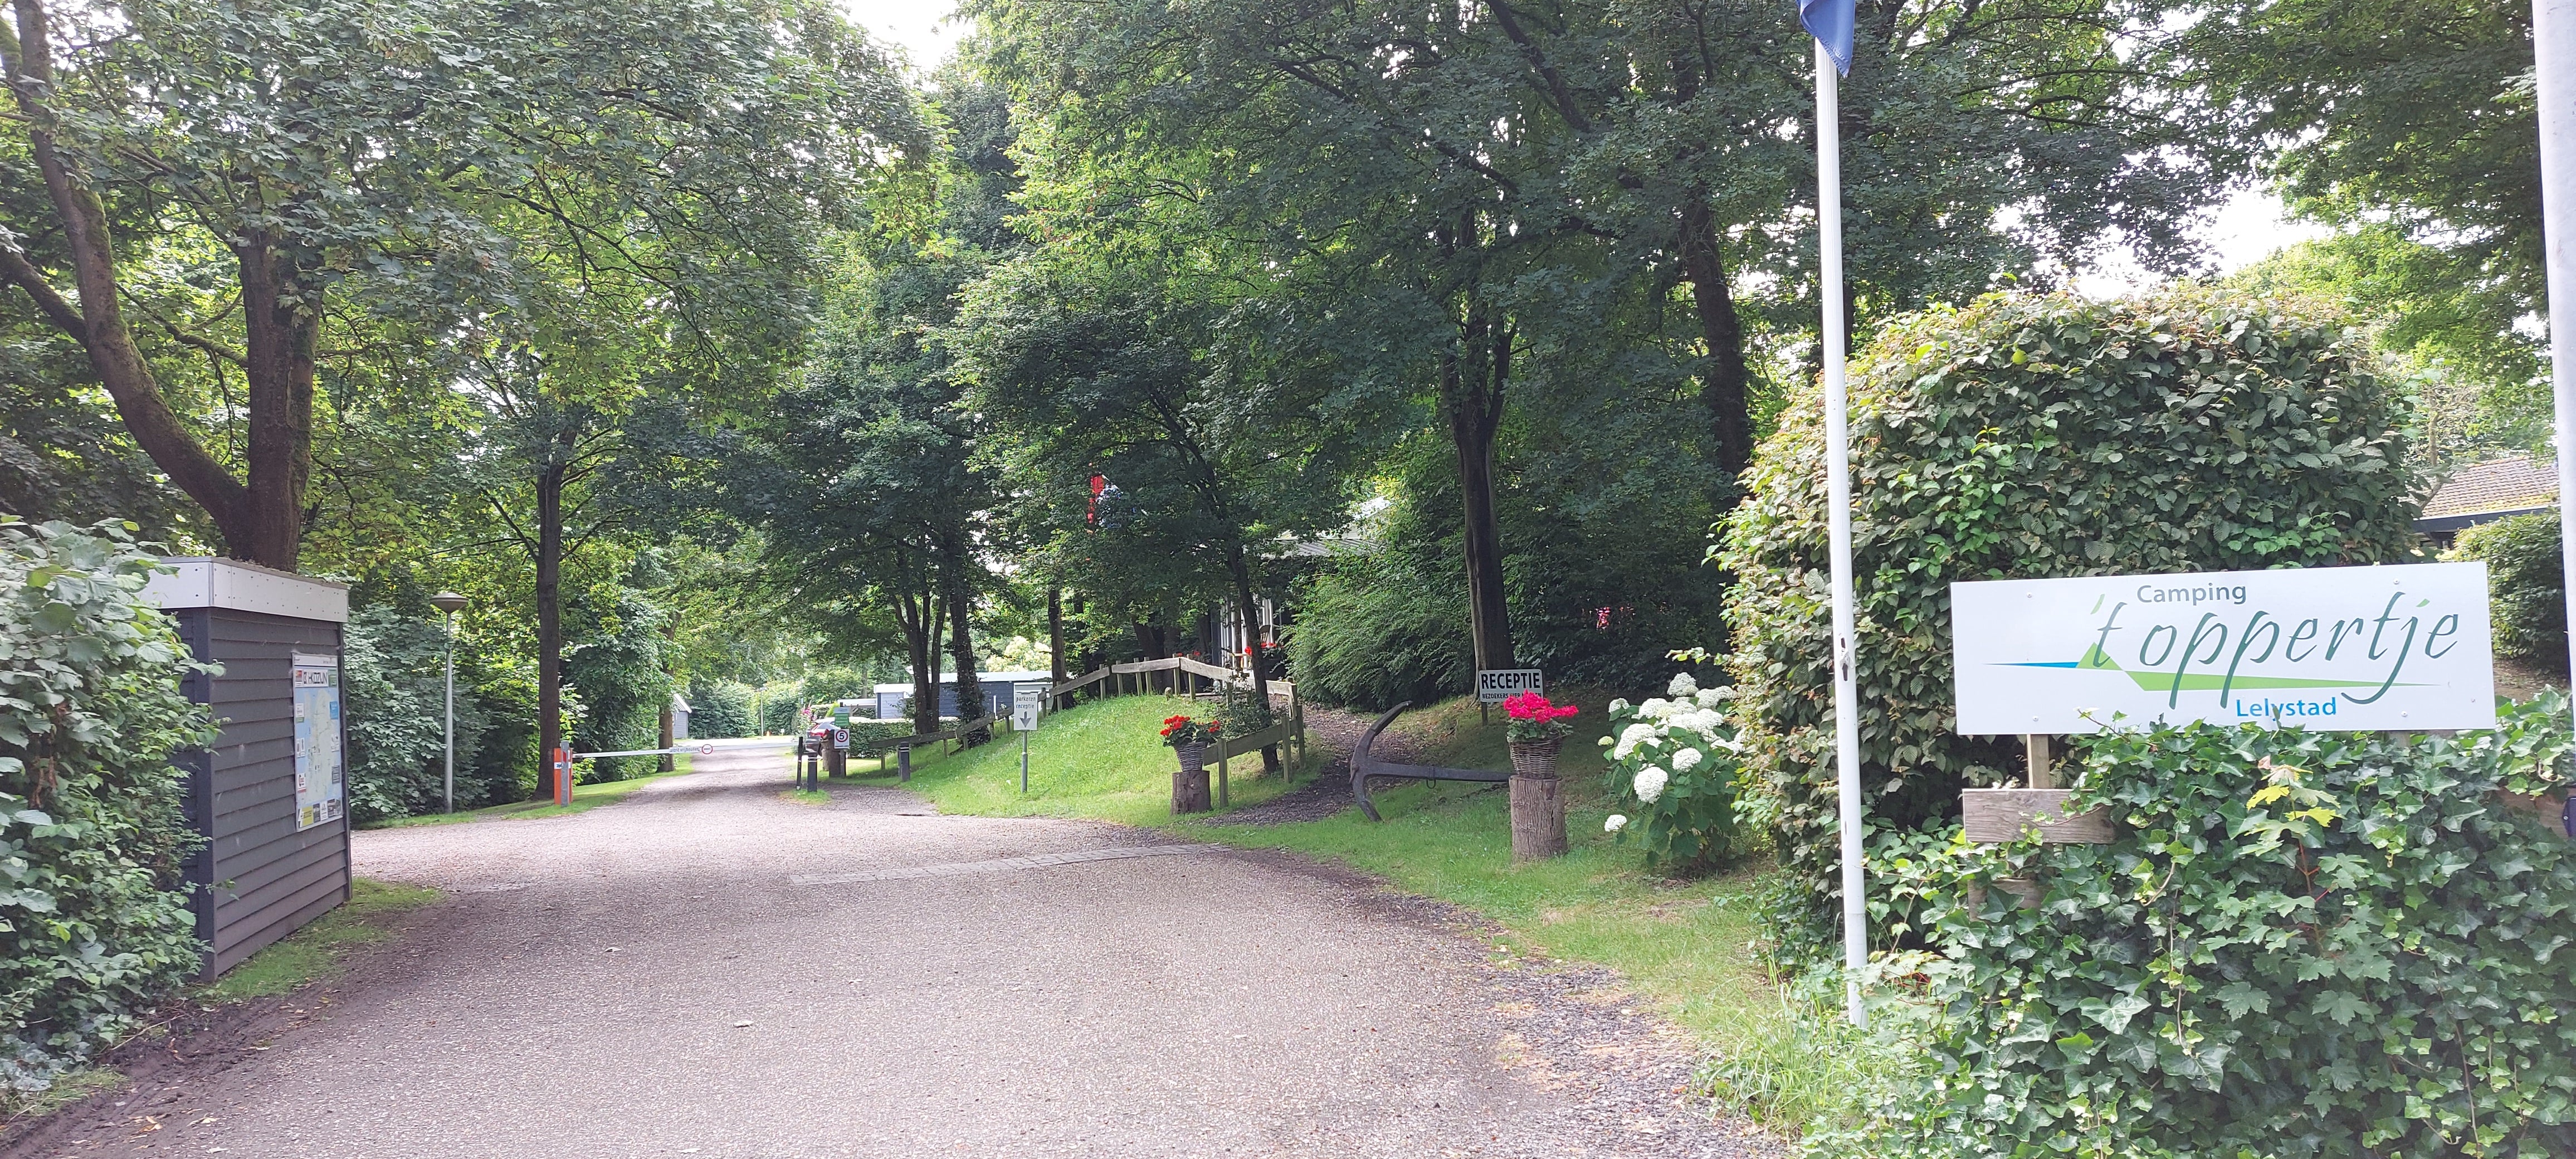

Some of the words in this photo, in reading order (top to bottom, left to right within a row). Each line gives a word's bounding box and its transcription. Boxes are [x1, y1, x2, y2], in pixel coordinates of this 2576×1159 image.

[2137, 582, 2247, 606] Camping
[2139, 591, 2458, 710] oppertje
[1481, 673, 1540, 689] RECEPTIE
[2236, 697, 2337, 722] Lelystad
